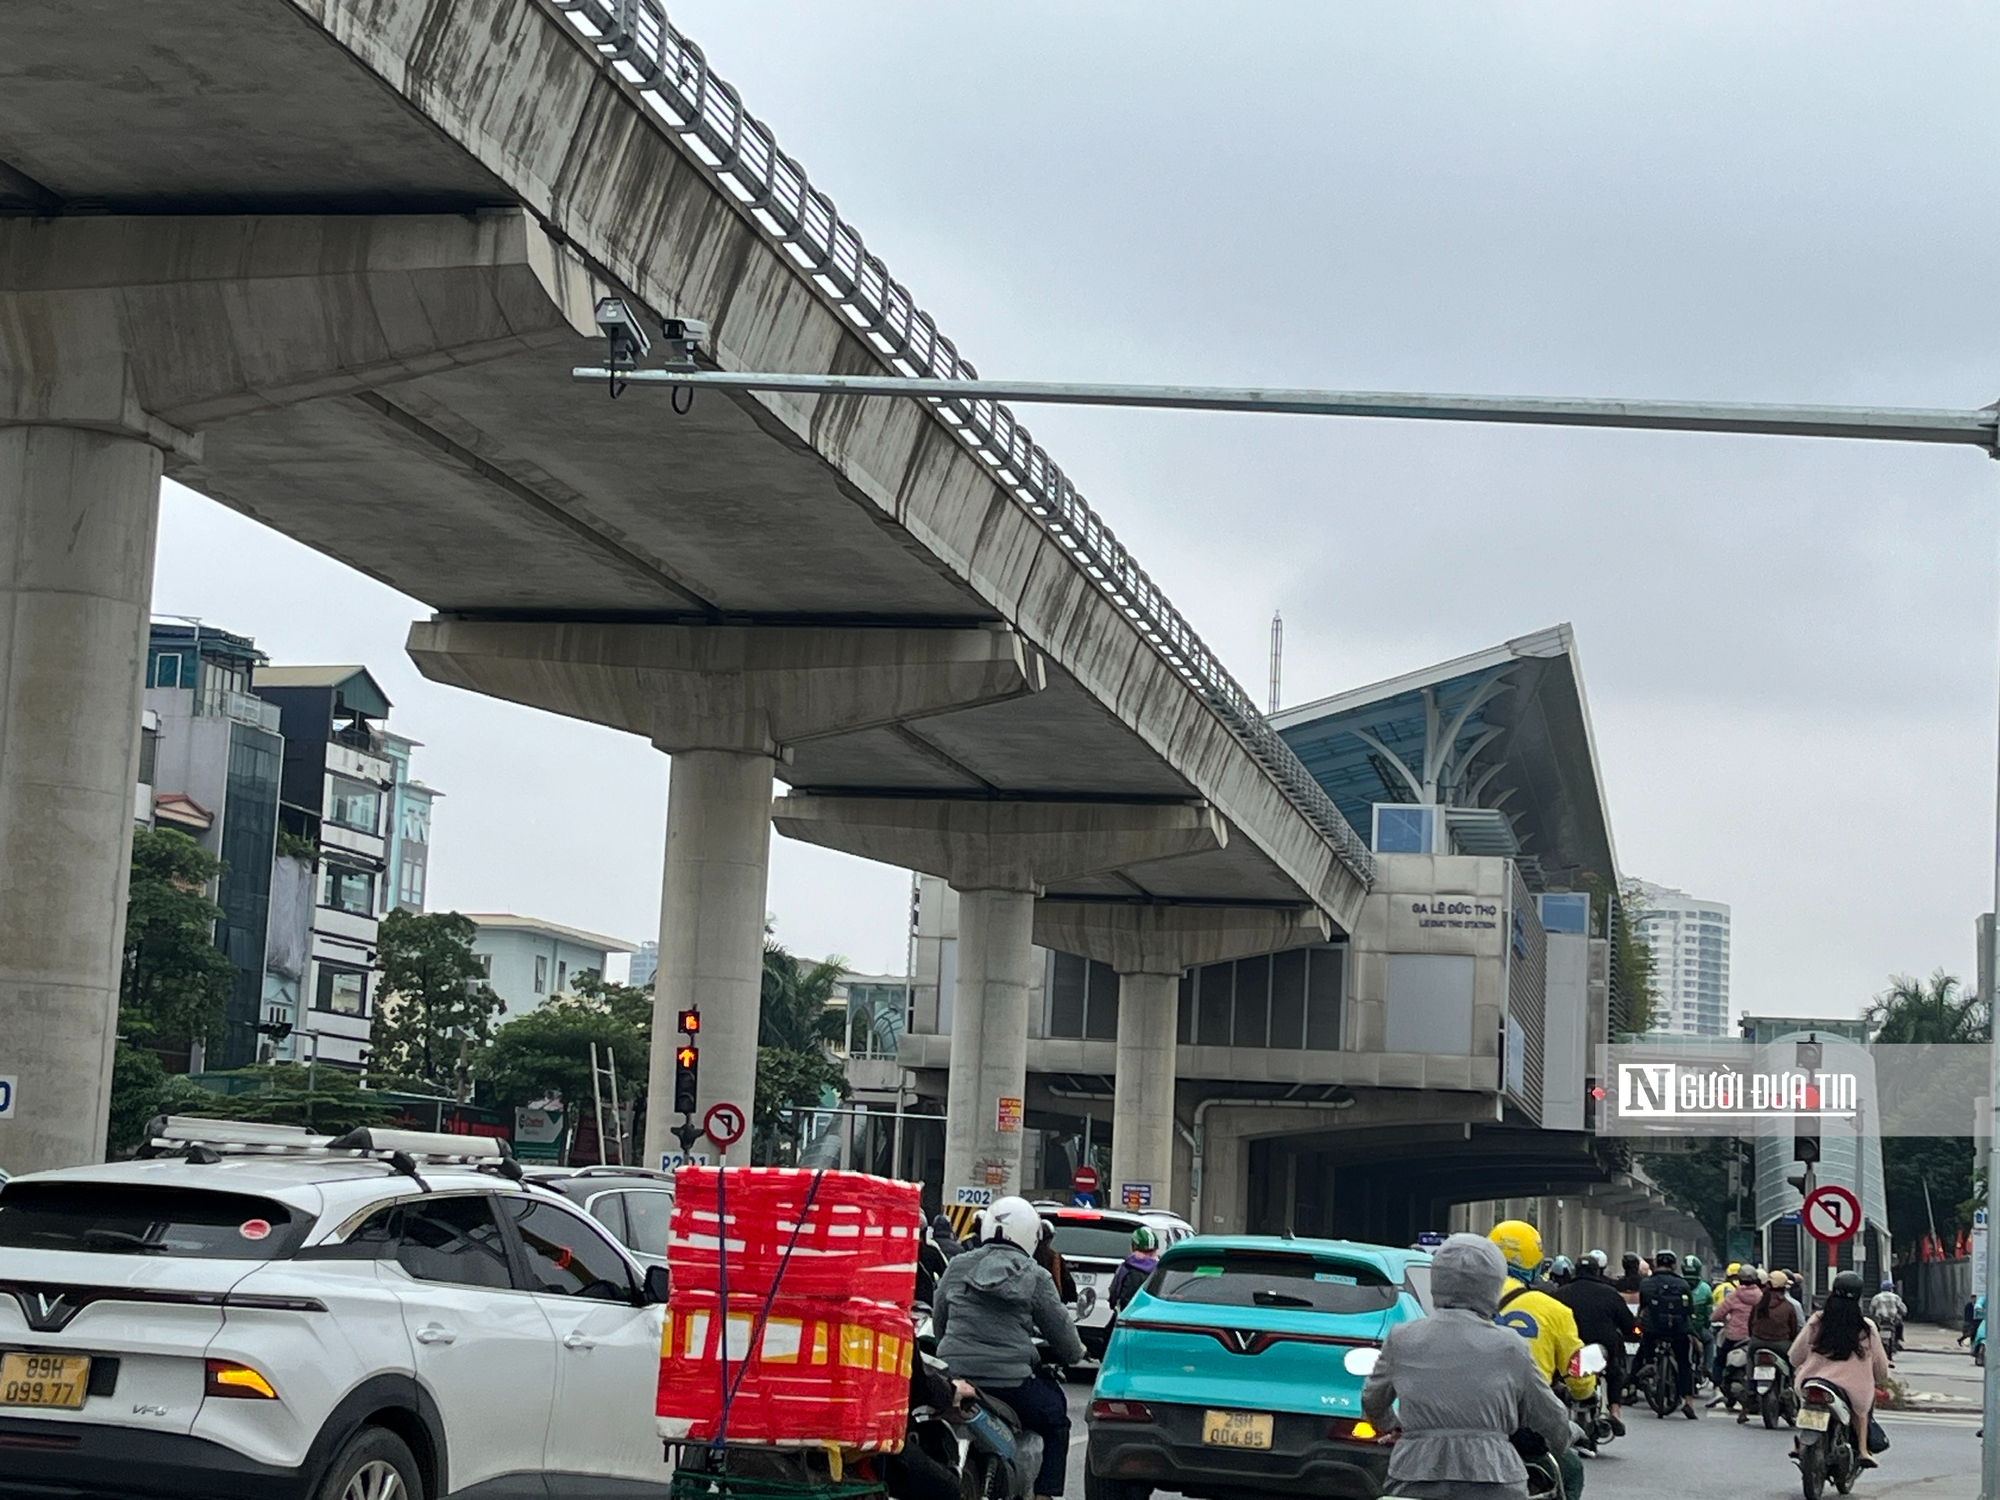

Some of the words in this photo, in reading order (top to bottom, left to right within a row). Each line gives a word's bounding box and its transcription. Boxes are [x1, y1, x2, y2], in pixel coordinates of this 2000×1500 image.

[1412, 903, 1428, 914] GA
[1431, 901, 1446, 914] LÊ
[958, 1190, 991, 1205] P202
[27, 1357, 64, 1379] 89H
[6, 1380, 74, 1404] 099.77
